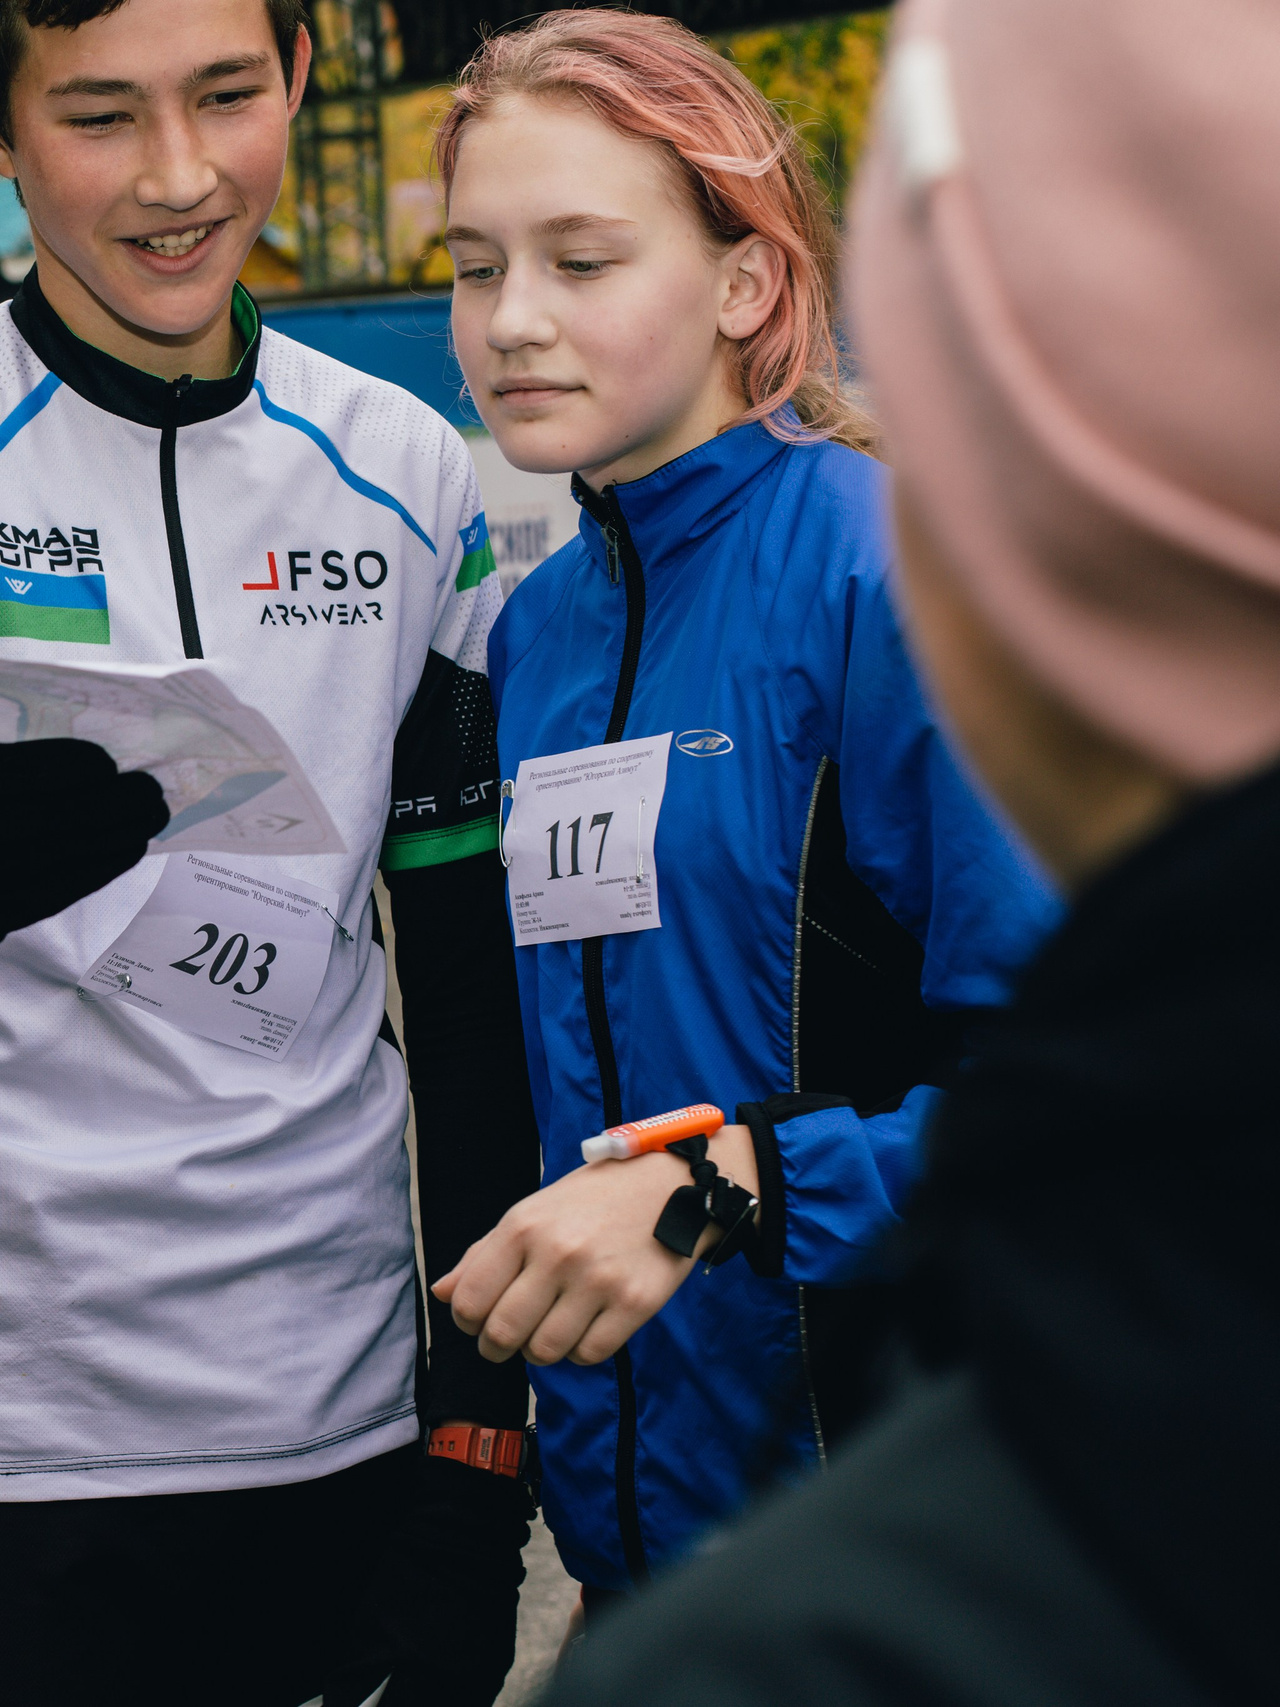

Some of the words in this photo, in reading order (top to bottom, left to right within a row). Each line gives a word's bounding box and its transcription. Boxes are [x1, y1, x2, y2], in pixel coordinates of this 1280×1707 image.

[260, 602, 383, 626] ARSWEAR
[546, 812, 614, 880] 117
[187, 854, 233, 877] Региональные
[233, 871, 275, 893] соревнования
[276, 886, 284, 896] по
[284, 888, 320, 910] спортивному
[194, 872, 250, 897] ориентированию
[135, 962, 154, 973] Данил
[169, 923, 277, 995] 203
